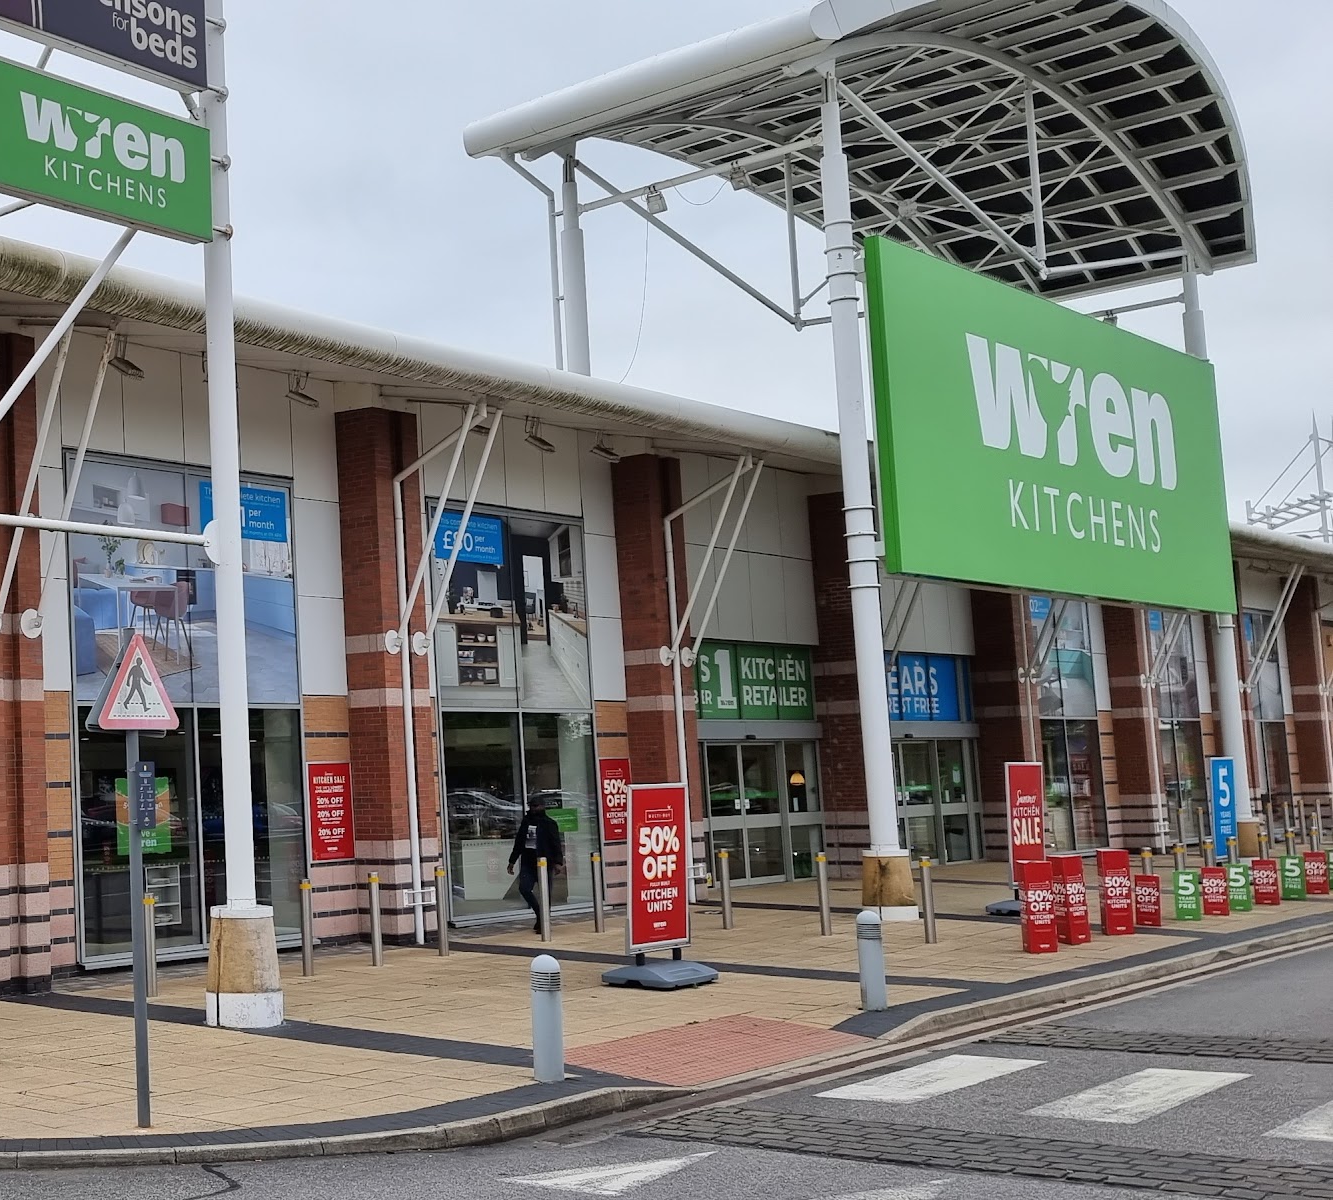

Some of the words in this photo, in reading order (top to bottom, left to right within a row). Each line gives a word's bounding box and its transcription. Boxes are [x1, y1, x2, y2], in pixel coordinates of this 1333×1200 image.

[99, 0, 197, 38] nsons
[112, 11, 130, 31] for
[130, 17, 198, 68] beds
[20, 91, 186, 184] wren
[45, 155, 167, 210] KITCHENS
[965, 332, 1177, 490] wren
[255, 493, 281, 504] kitchen
[248, 509, 262, 518] per
[1009, 478, 1161, 553] KITCHENS
[248, 520, 275, 530] month
[474, 535, 485, 543] per
[475, 545, 496, 554] month
[740, 656, 806, 682] KITCHEN
[887, 665, 939, 696] EARS
[742, 684, 808, 706] RETAILER
[604, 779, 627, 795] 50%
[1219, 767, 1231, 807] 5
[607, 795, 626, 807] OFF
[1013, 806, 1040, 817] KITCHEN
[1013, 817, 1042, 846] SALE
[141, 839, 157, 847] ren
[638, 825, 680, 855] 50%
[642, 854, 678, 881] OFF
[1285, 857, 1301, 877] 5
[1305, 862, 1327, 870] 50%
[1229, 867, 1246, 887] 5
[1253, 870, 1276, 879] 50%
[1066, 882, 1085, 895] 50%
[1105, 876, 1130, 888] 50%
[1178, 874, 1195, 895] 5
[1202, 878, 1227, 887] 50%
[641, 887, 678, 902] KITCHEN
[1027, 889, 1054, 902] 50%
[1107, 887, 1129, 897] OFF
[1136, 886, 1159, 896] 50%
[1069, 894, 1084, 904] OFF
[1137, 896, 1157, 904] OFF
[647, 900, 673, 913] UNITS
[1030, 902, 1052, 912] OFF
